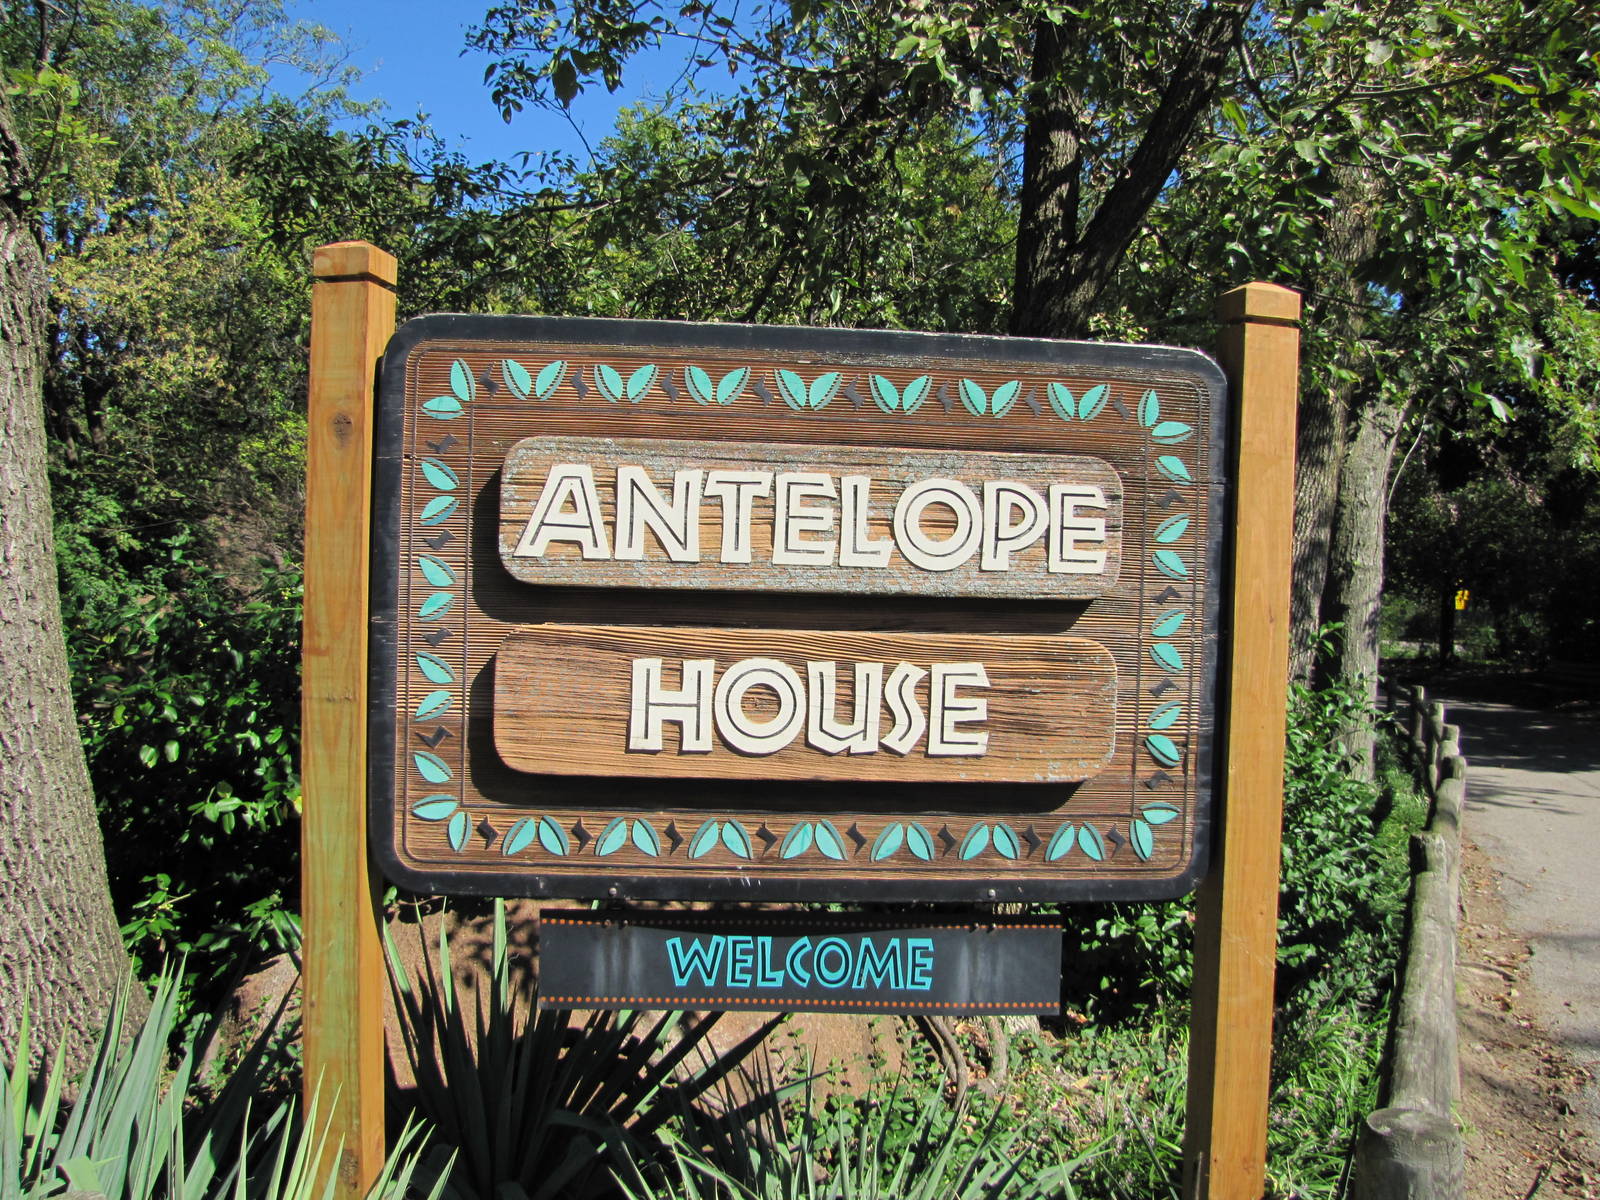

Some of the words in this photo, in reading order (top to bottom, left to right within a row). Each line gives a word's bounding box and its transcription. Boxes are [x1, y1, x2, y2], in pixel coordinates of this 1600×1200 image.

[513, 464, 1107, 574] ANTELOPE
[628, 657, 990, 756] HOUSE
[665, 934, 934, 991] WELCOME
